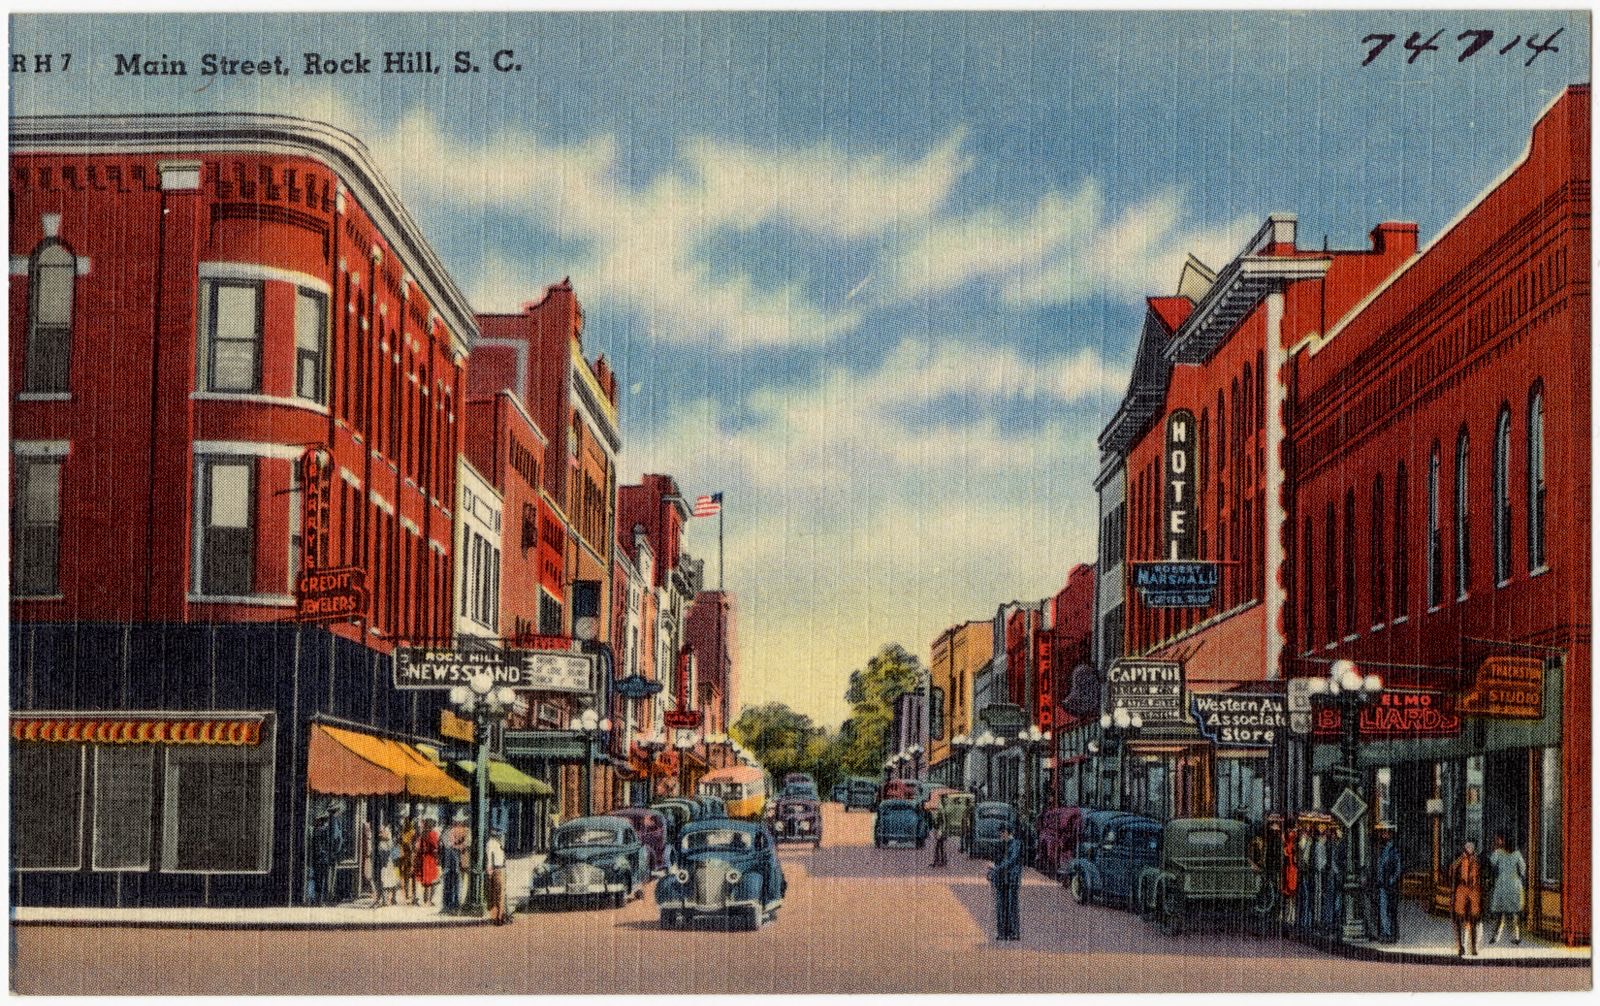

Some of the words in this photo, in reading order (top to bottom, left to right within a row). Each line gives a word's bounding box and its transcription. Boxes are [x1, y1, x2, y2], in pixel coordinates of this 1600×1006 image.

[1361, 28, 1564, 66] 74714
[1170, 421, 1186, 563] HOTEL
[301, 573, 350, 593] CREDIT
[1137, 568, 1218, 585] MARSHALL
[425, 652, 463, 662] ROCK
[469, 652, 504, 663] HILL
[408, 664, 520, 683] NEWSSTAND
[1197, 698, 1258, 712] Western
[1382, 695, 1432, 706] ELMO
[1221, 727, 1275, 743] Store
